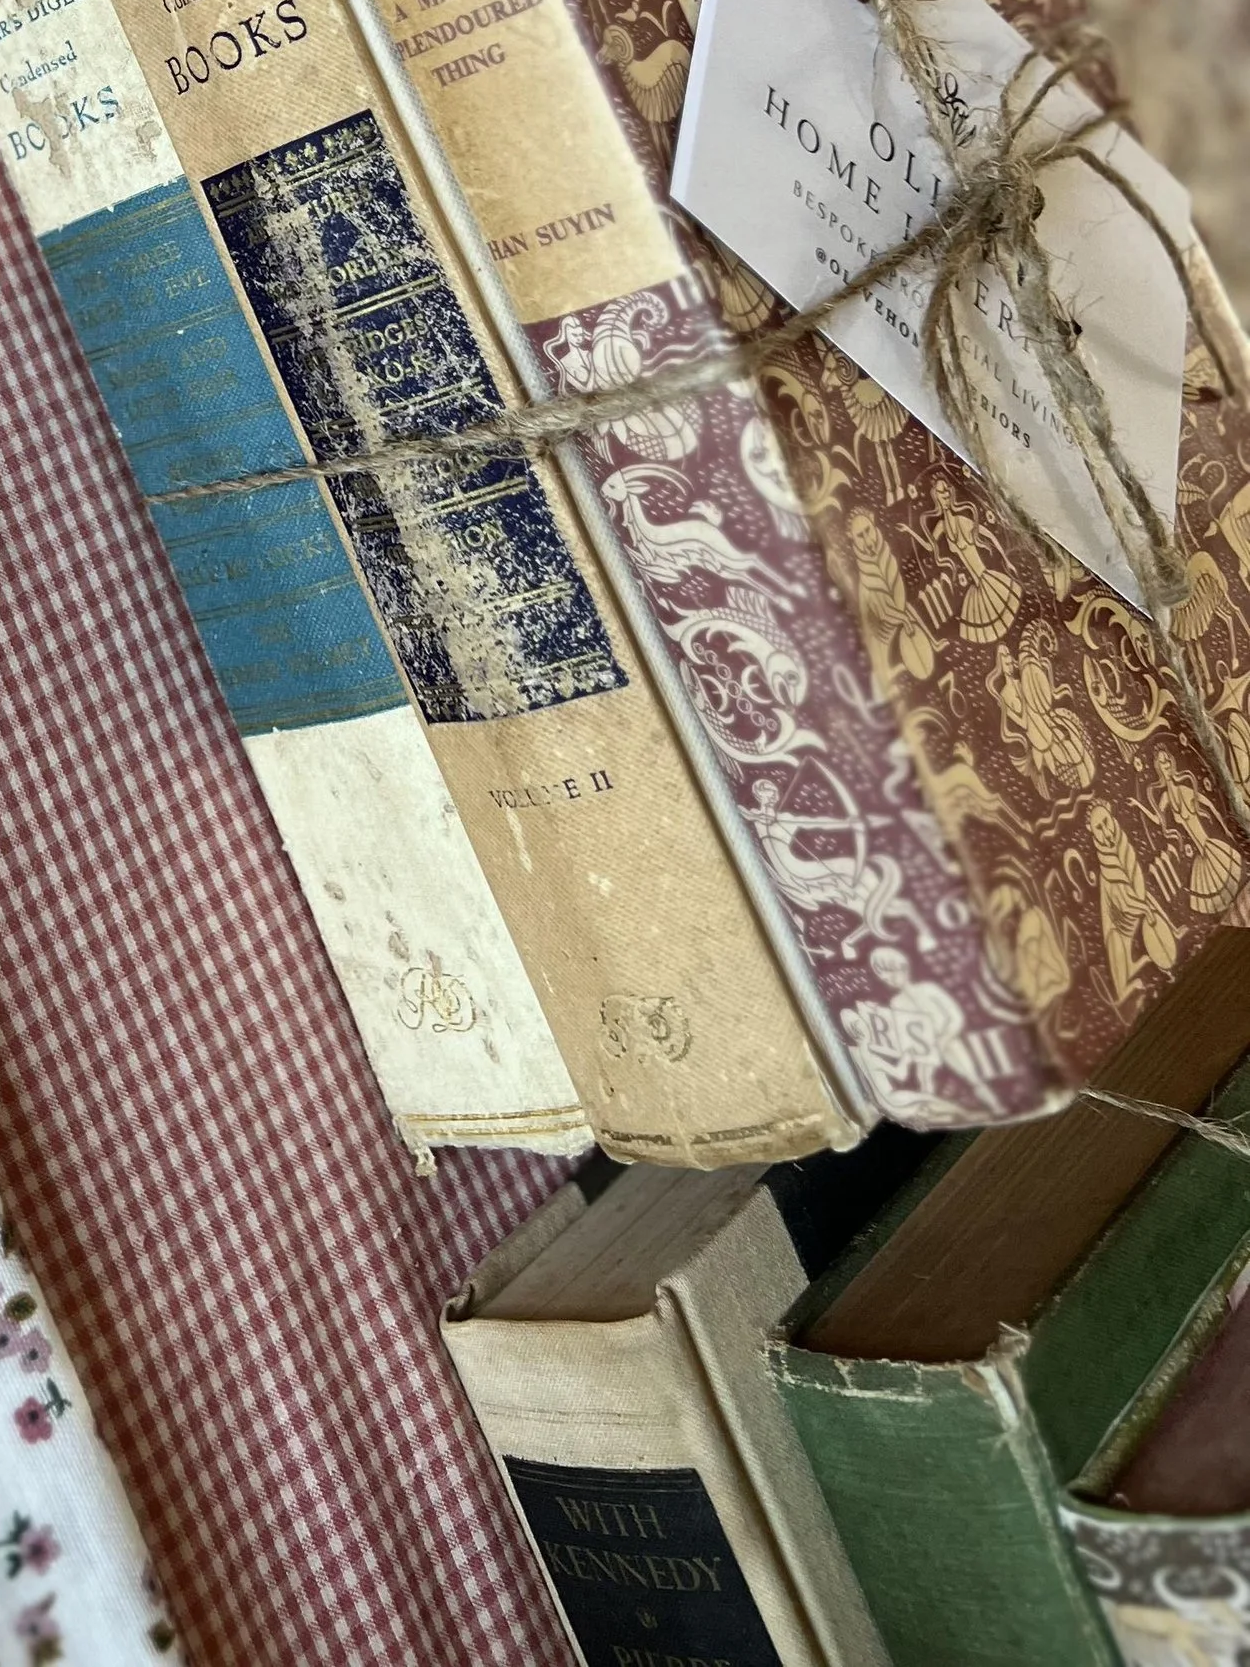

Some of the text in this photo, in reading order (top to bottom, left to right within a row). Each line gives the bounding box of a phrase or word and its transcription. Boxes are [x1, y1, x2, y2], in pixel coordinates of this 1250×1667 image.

[394, 2, 408, 23] A
[431, 42, 506, 88] THING
[764, 85, 881, 215] HOME
[486, 203, 617, 262] HAN SUYIN
[589, 769, 614, 793] II
[556, 1496, 667, 1540] WITH
[542, 1540, 722, 1593] KENNEDY
